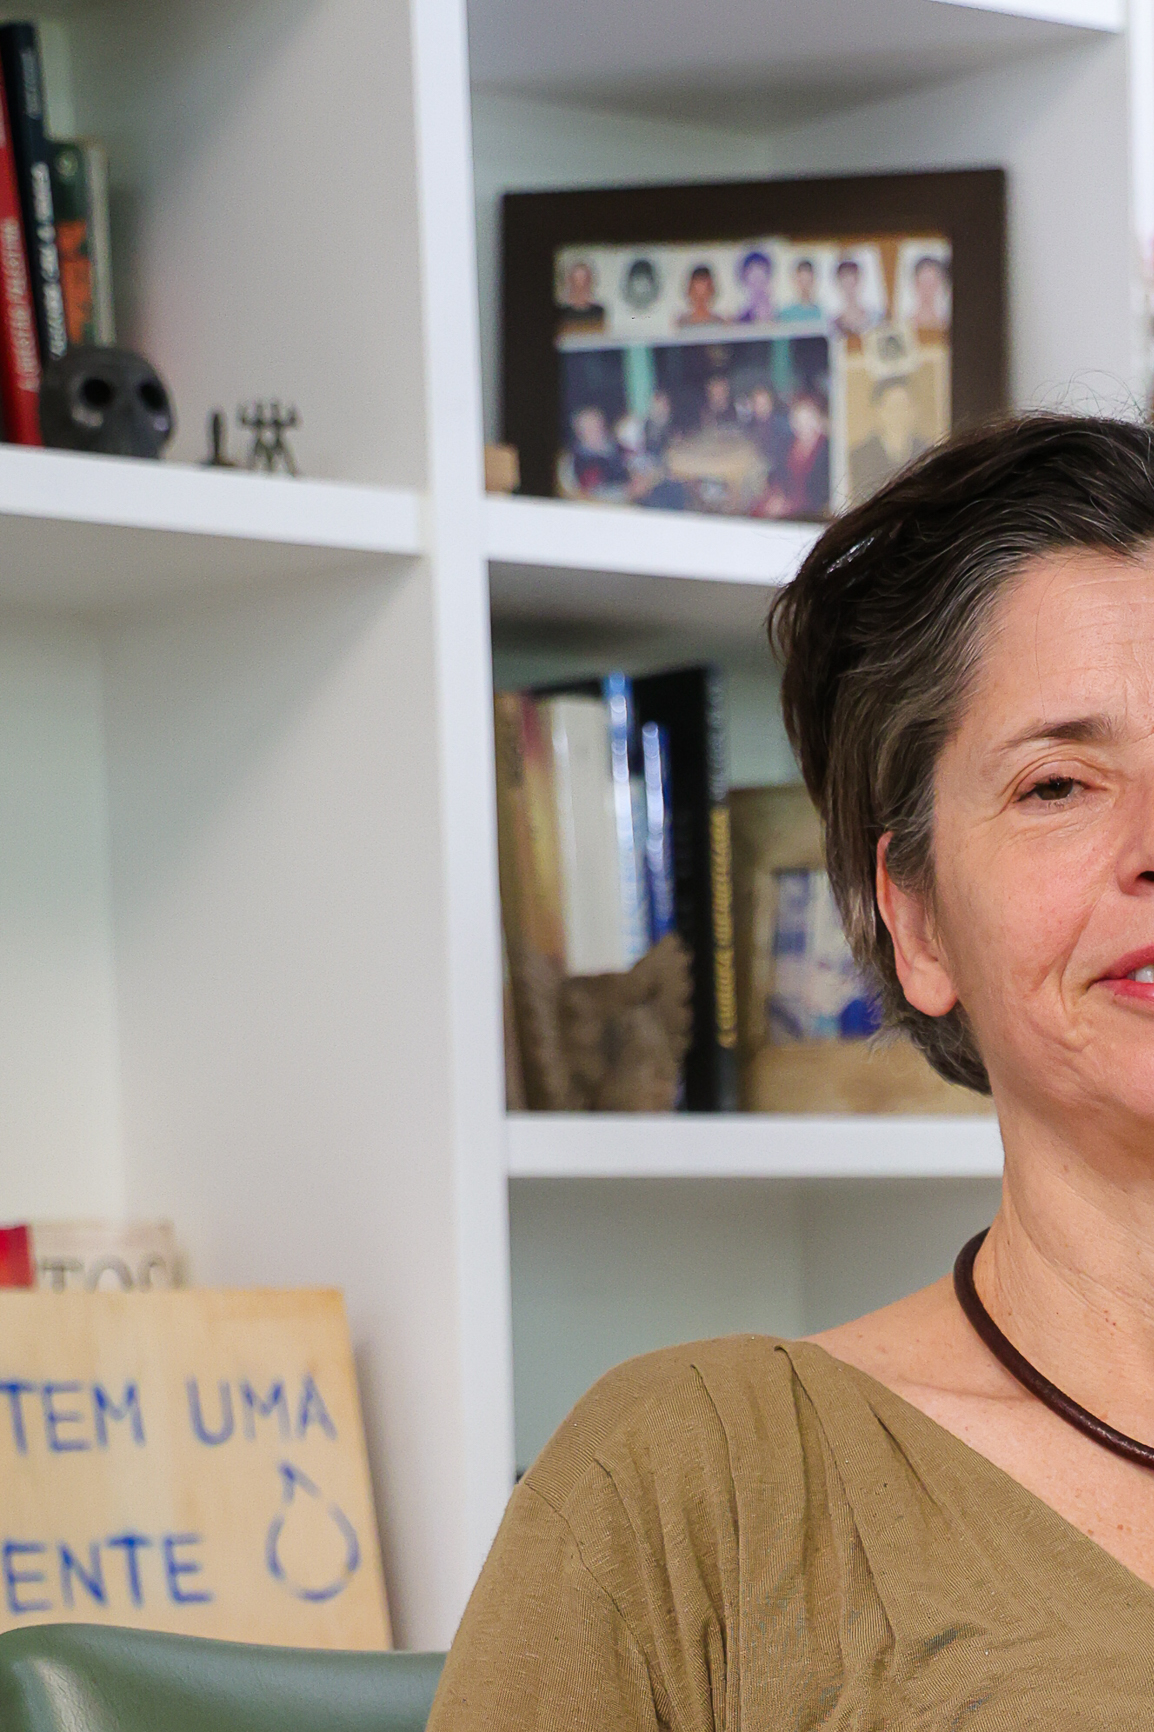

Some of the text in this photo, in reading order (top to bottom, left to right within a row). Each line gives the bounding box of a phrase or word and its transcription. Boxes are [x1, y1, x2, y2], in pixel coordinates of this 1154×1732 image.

[0, 1372, 338, 1454] TEM UMA
[3, 1532, 214, 1614] ENTE
